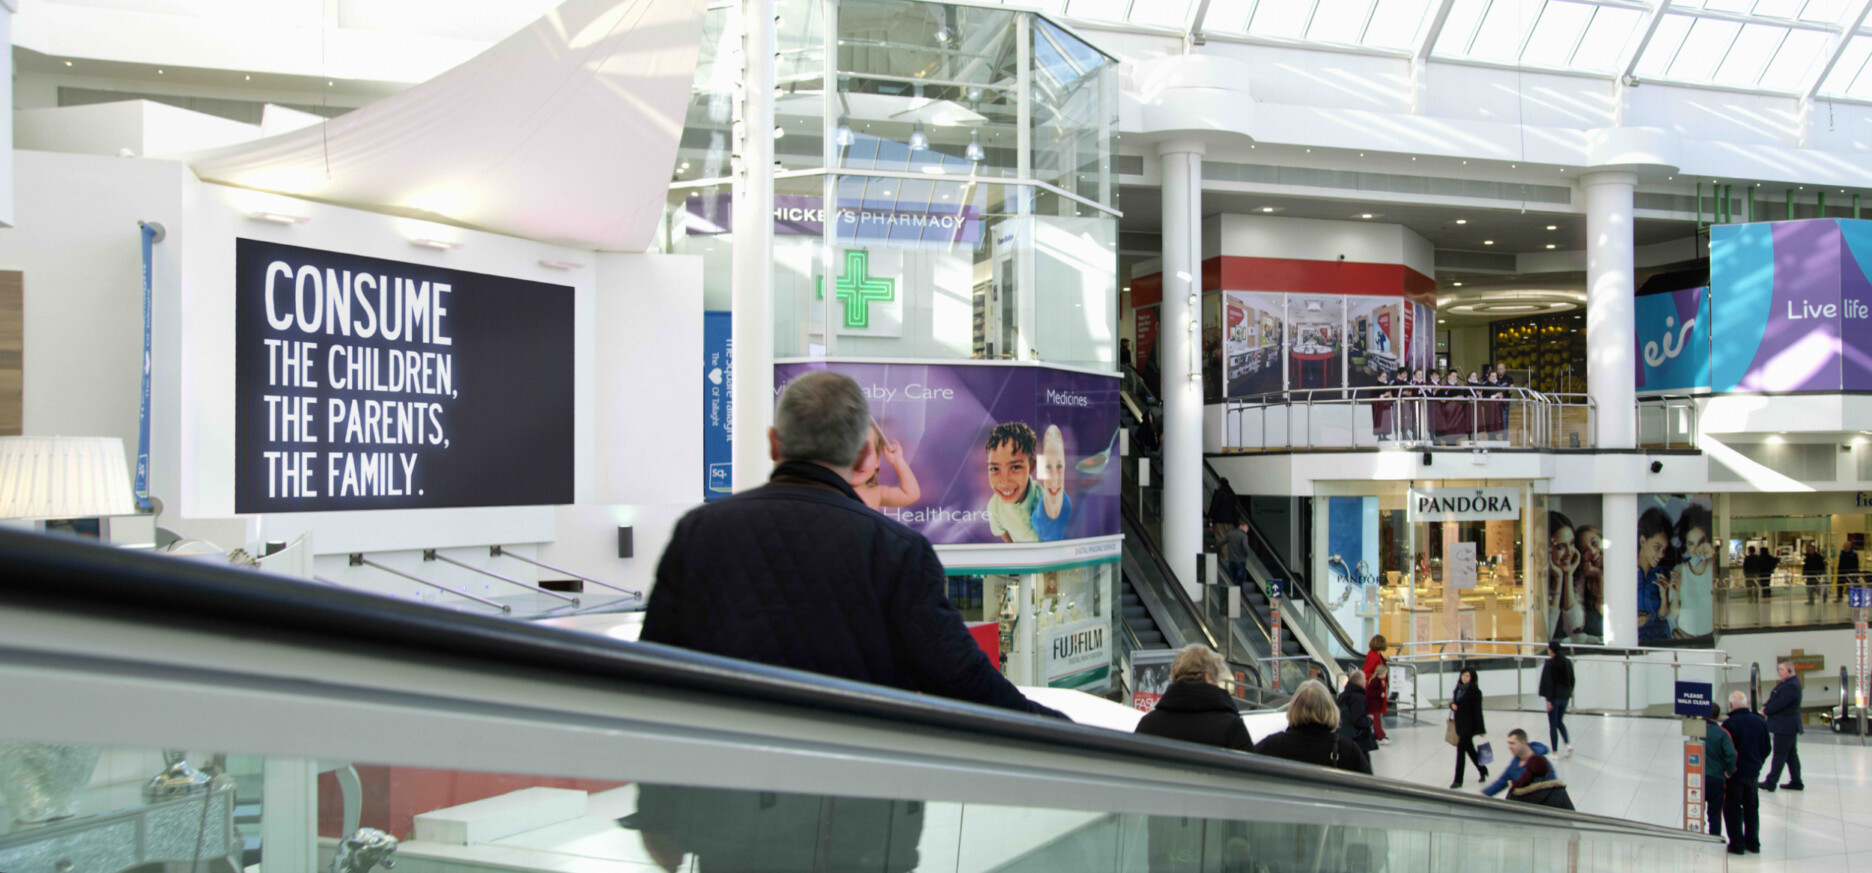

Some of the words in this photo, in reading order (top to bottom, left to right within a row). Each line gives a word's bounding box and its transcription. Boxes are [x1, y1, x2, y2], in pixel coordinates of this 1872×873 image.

[861, 212, 965, 230] PHARMACY
[264, 260, 453, 346] CONSUME
[1787, 300, 1838, 319] Live
[1844, 298, 1869, 319] life
[1644, 315, 1695, 367] eir
[263, 338, 318, 388] THE
[328, 344, 458, 400] CHILDREN,
[711, 352, 720, 366] The
[864, 383, 897, 403] aby
[904, 383, 954, 400] Care
[1046, 388, 1088, 407] Medicines
[263, 394, 318, 443] THE
[328, 397, 450, 449] PARENTS,
[710, 398, 720, 427] Tallaght
[263, 451, 318, 498] THE
[328, 452, 424, 497] FAMILY.
[883, 506, 993, 522] Healthcare
[1418, 494, 1512, 513] PANDORA
[1053, 628, 1103, 660] FUJIFILM
[1683, 692, 1704, 700] PLEASE
